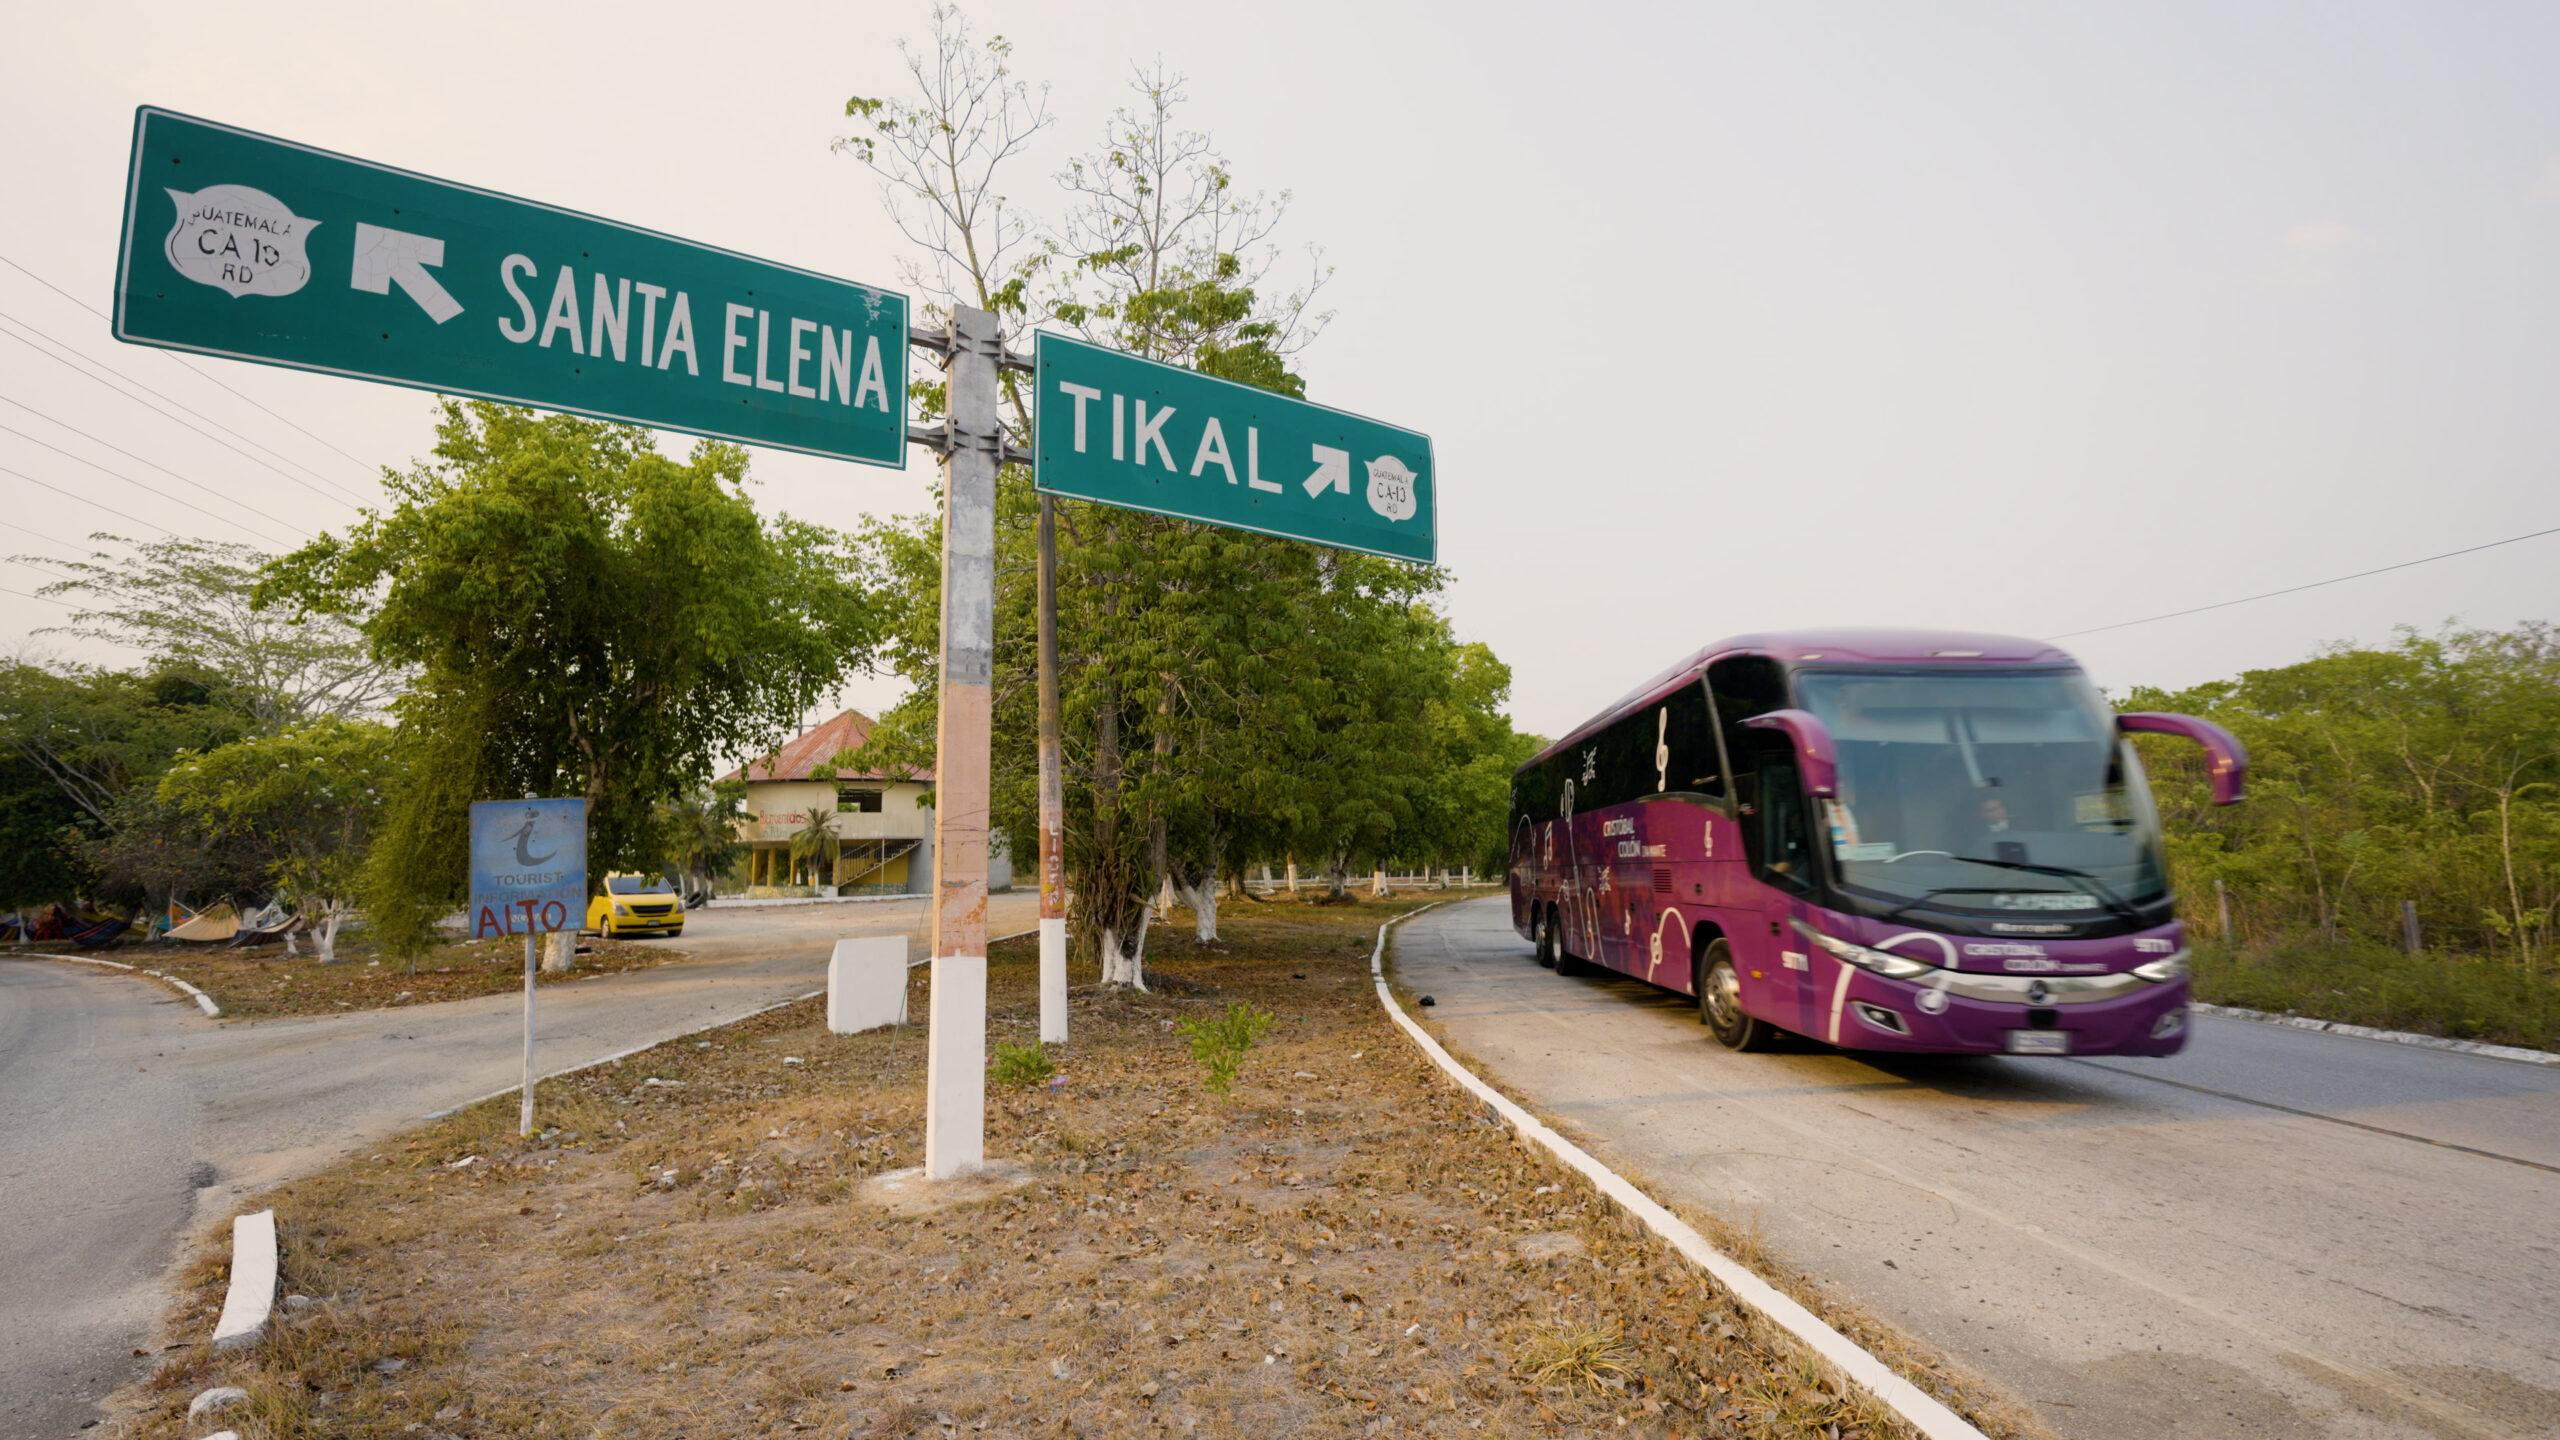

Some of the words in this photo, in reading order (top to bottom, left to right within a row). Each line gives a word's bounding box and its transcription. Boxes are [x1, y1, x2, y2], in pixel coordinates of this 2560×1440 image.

[198, 229, 241, 260] CA
[222, 263, 253, 284] RD
[498, 253, 699, 376] SANTA
[723, 302, 890, 413] ELENA
[1059, 381, 1283, 494] TIKAL
[1376, 482, 1407, 503] CA-13
[495, 871, 562, 887] TOURIST
[474, 886, 583, 905] INFORMATION
[476, 898, 567, 939] ALTO
